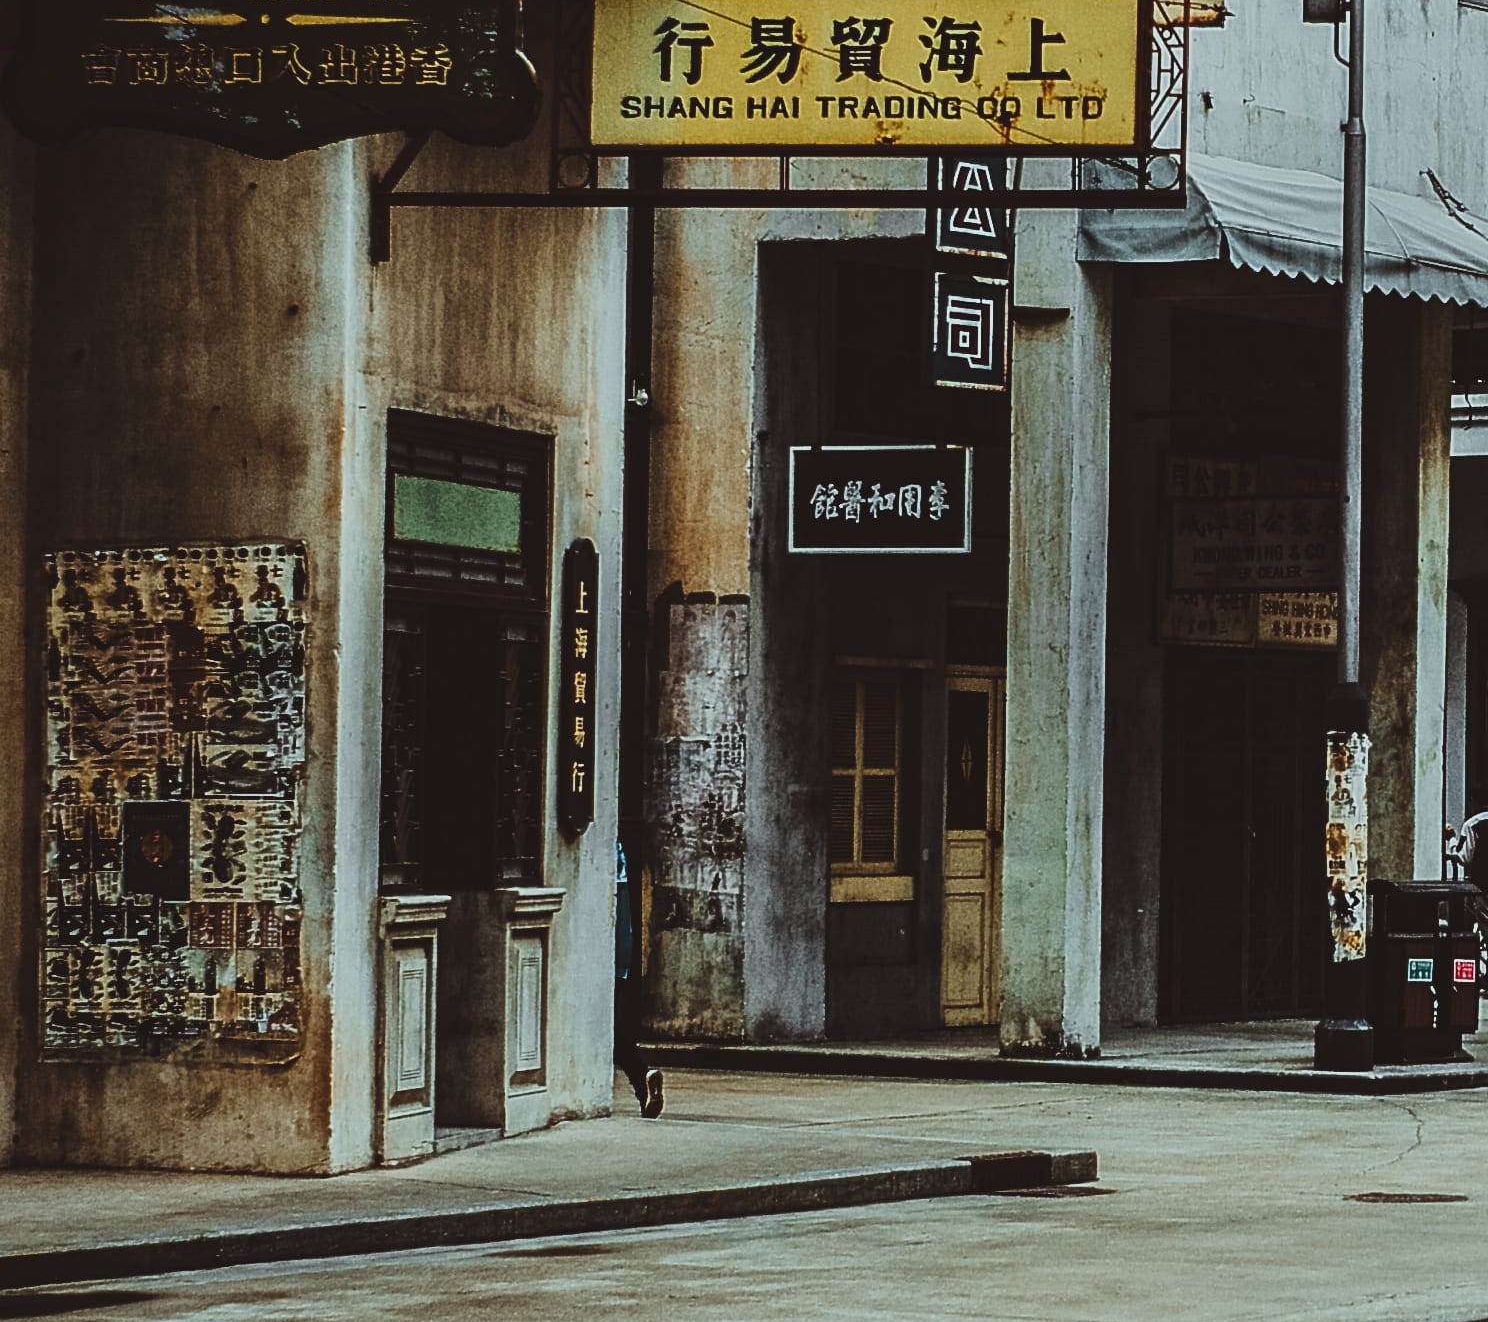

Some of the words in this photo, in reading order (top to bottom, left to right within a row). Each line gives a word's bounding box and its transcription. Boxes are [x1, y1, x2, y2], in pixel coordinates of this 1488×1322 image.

[620, 95, 734, 120] SHANG
[746, 95, 800, 120] HAI
[815, 95, 961, 120] TRADING
[976, 95, 1022, 121] CO
[1035, 95, 1104, 120] LTD
